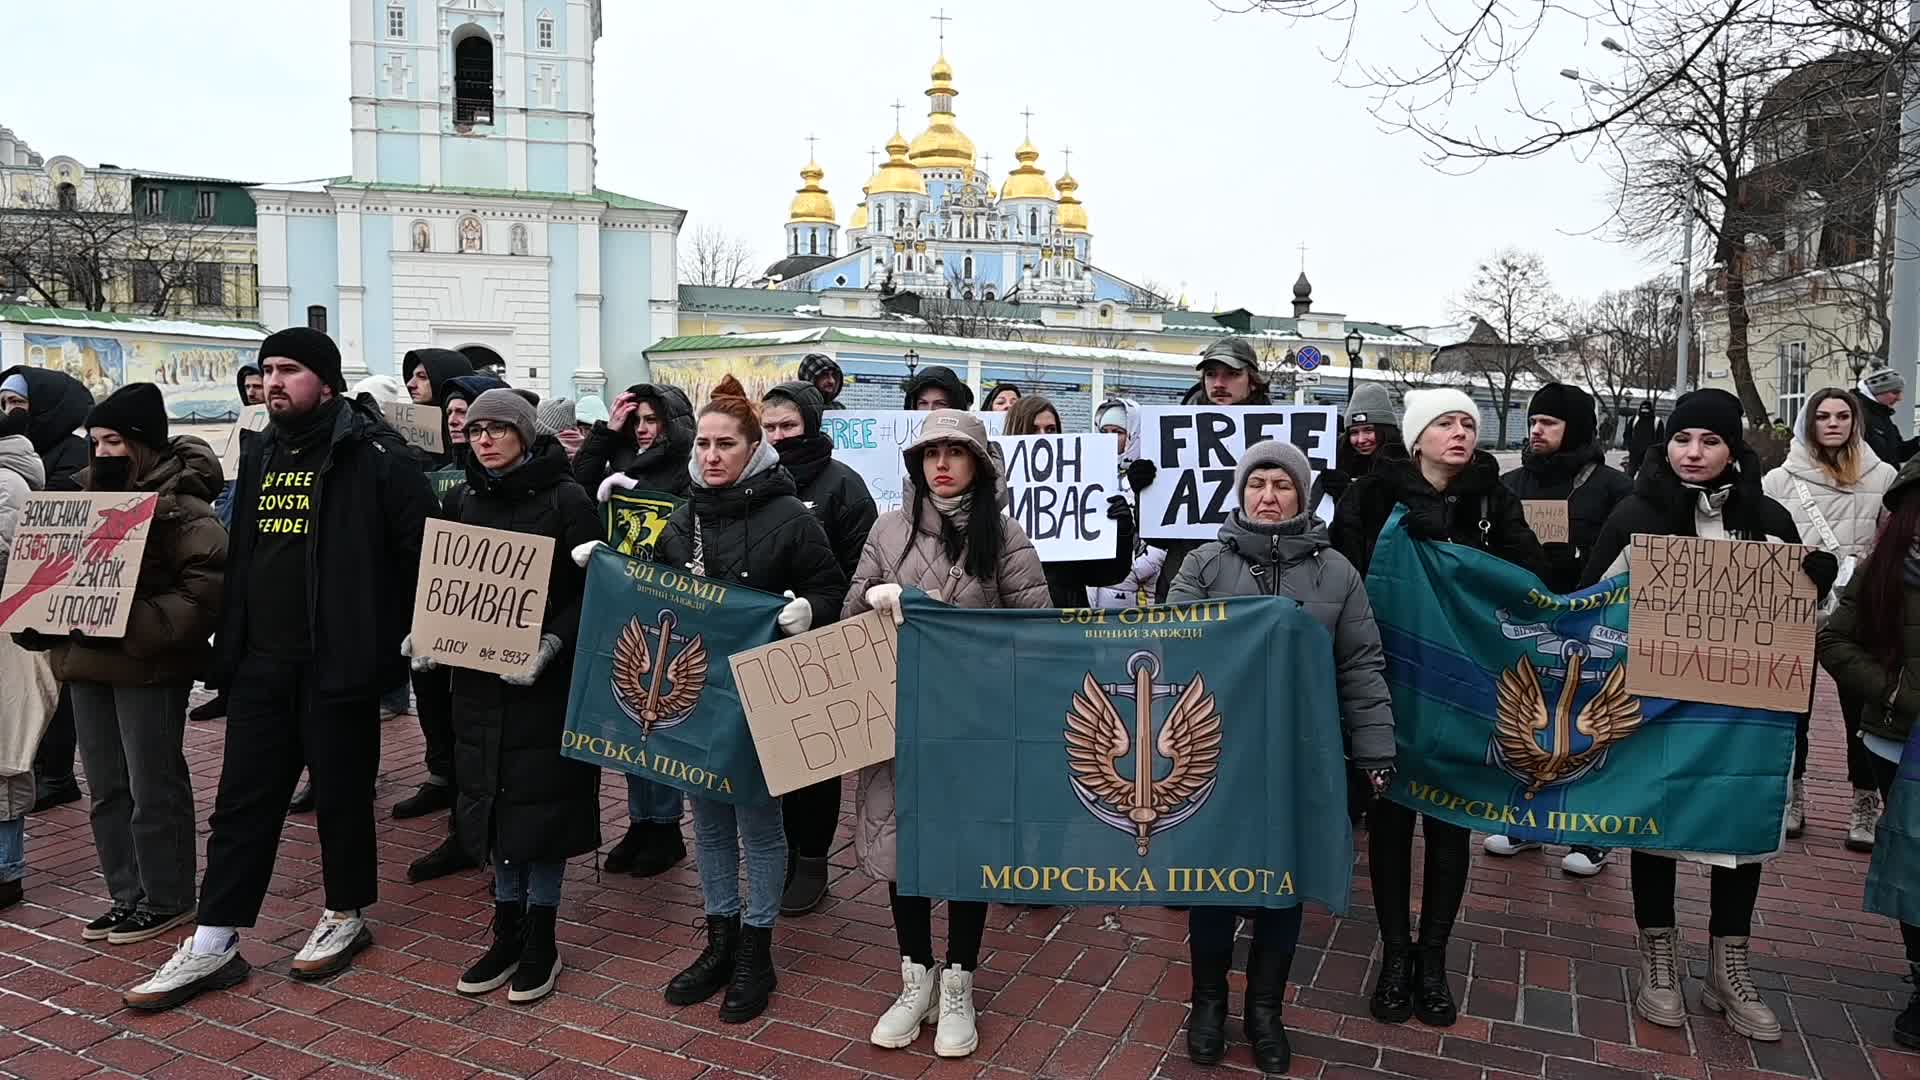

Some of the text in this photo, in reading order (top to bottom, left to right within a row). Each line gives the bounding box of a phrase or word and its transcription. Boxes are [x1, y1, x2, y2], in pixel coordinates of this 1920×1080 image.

[1160, 412, 1328, 471] FREE
[20, 500, 92, 527] ЗАХИСНИКИ
[432, 530, 537, 580] ПОЛОН
[1633, 535, 1716, 567] ЧЕКАЮ
[623, 560, 728, 605] 501 ОБМП
[1648, 561, 1796, 598] ХВИЛИНУ
[46, 594, 58, 623] У
[426, 577, 539, 629] ВБИВАЄ
[1118, 601, 1229, 625] ОБМП
[1633, 585, 1817, 624] АБИ ПОБАЧИТИ
[432, 637, 469, 655] ДПСУ
[1664, 612, 1774, 647] СВОГО
[1638, 637, 1806, 693] ЧОЛОВІКА
[790, 680, 897, 771] БРА
[653, 754, 733, 794] ПІХОТА
[1407, 780, 1659, 835] МОРСЬКА ПІХОТА
[980, 864, 1296, 896] МОРСЬКА ПІХОТА
